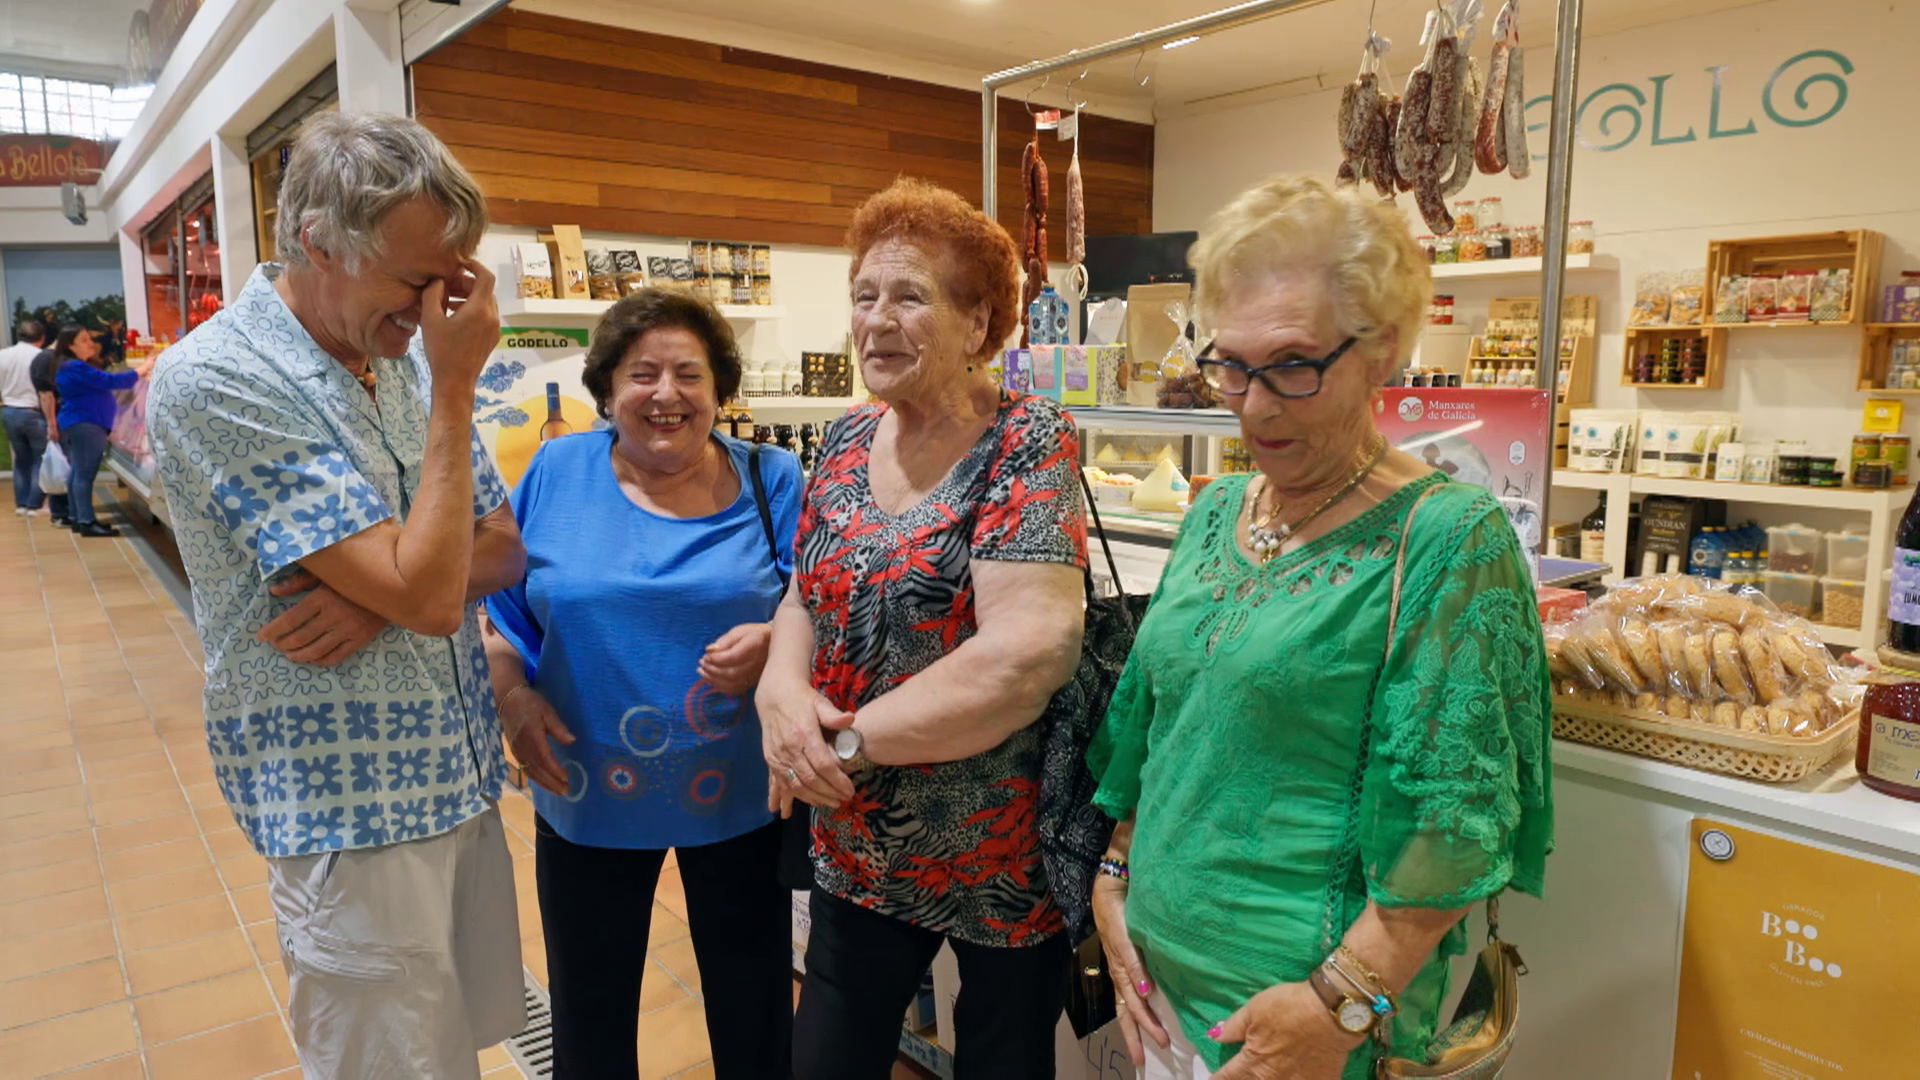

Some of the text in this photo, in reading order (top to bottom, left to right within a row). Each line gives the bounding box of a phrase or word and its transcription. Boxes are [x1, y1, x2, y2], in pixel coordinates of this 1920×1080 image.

[8, 145, 89, 181] Bellota
[507, 338, 568, 348] GODELLO
[1428, 400, 1476, 410] Manxares
[1427, 411, 1476, 420] de Galicia
[1793, 1048, 1844, 1072] PRODUCTOS
